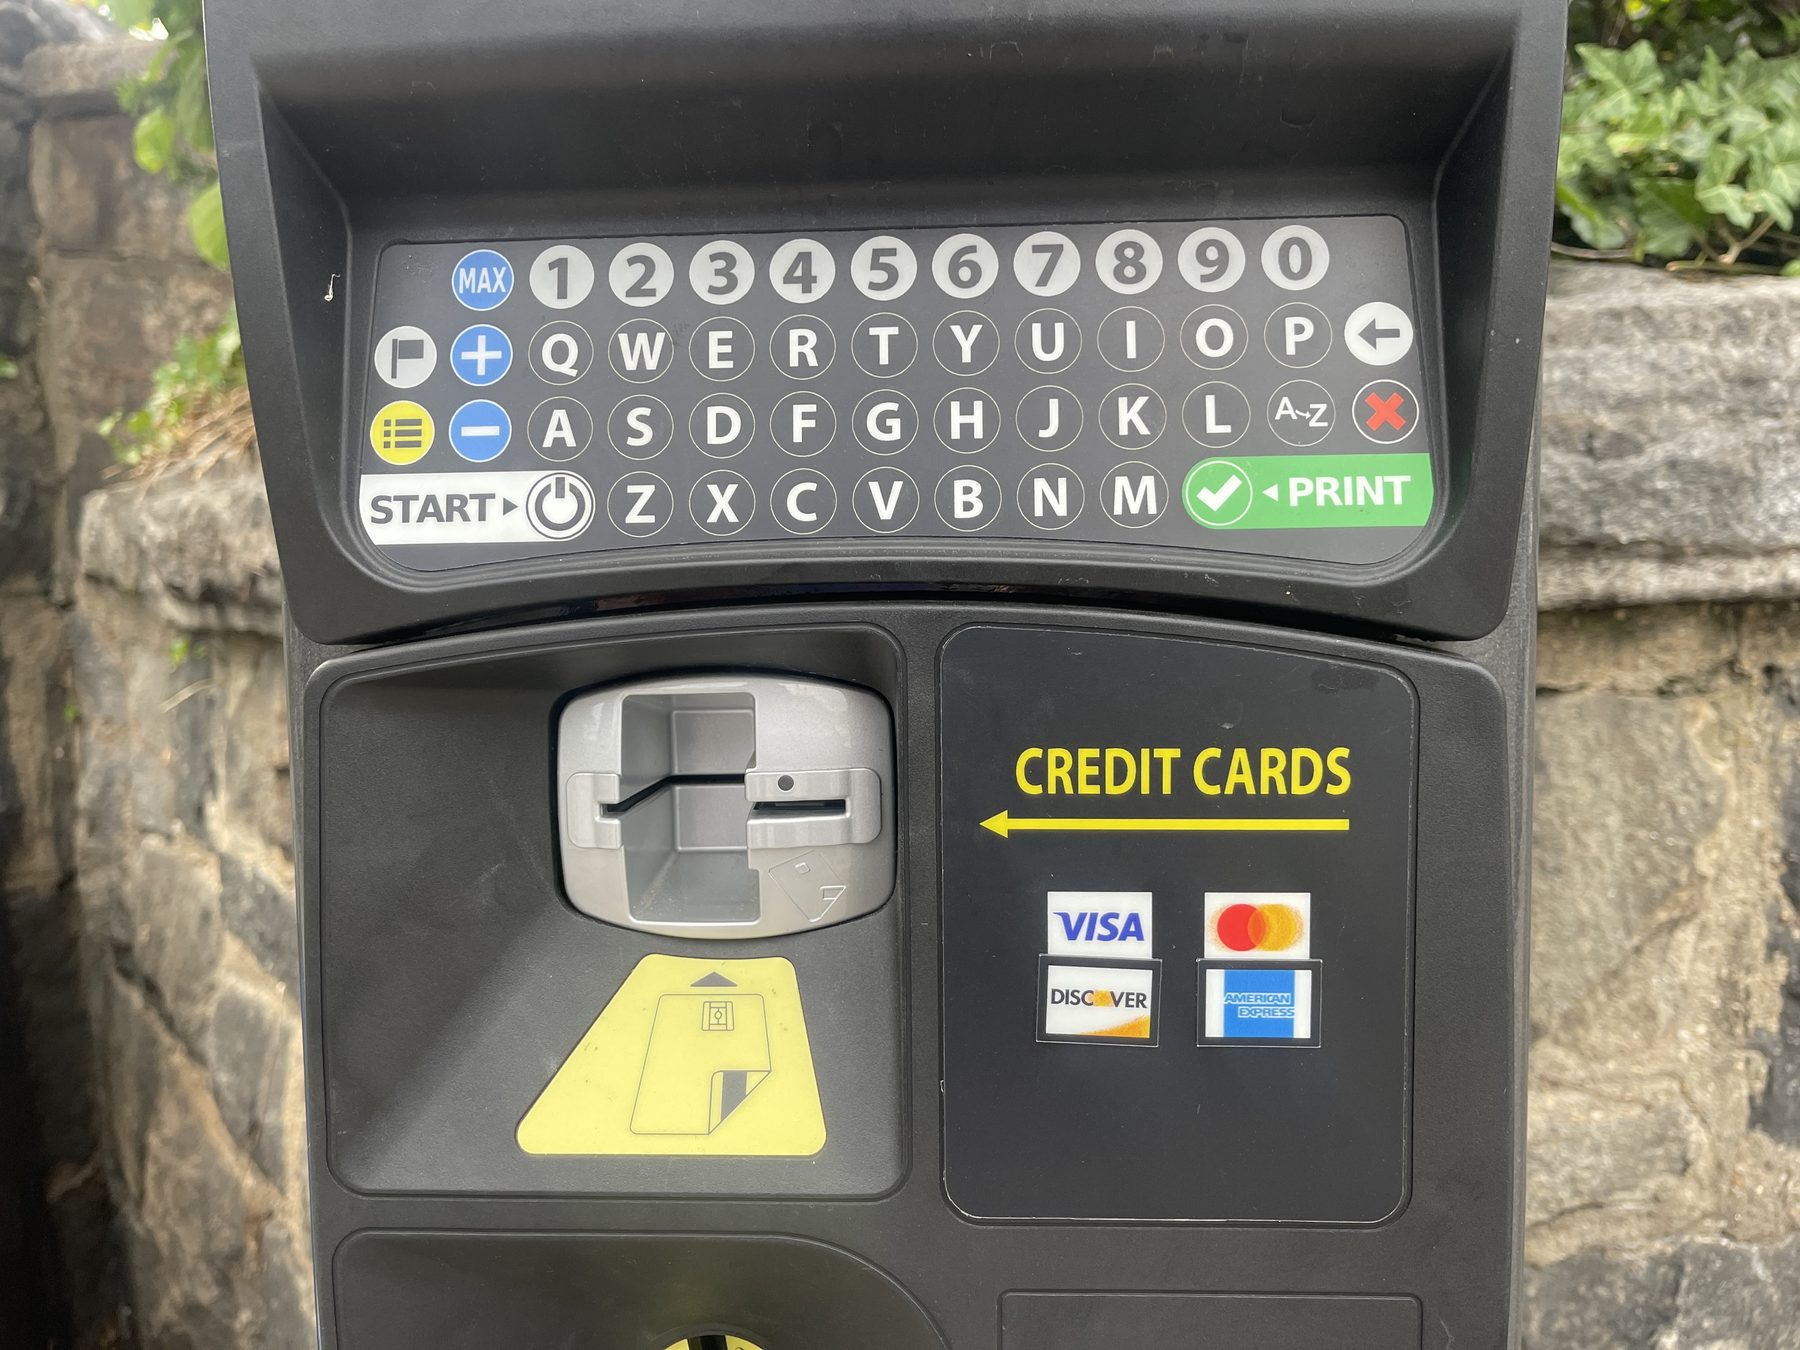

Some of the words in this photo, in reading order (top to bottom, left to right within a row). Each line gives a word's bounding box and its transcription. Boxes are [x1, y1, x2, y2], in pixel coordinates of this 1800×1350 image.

[459, 267, 506, 293] MAX
[548, 257, 569, 299] 1
[625, 255, 657, 298] 2
[708, 252, 738, 295] 3
[783, 251, 817, 294] 4
[868, 247, 899, 291] 5
[948, 245, 982, 289] 6
[1031, 244, 1063, 287] 7
[1113, 241, 1146, 285] 8
[1195, 239, 1229, 283] 9
[1278, 237, 1312, 279] 0
[541, 333, 578, 377] Q
[618, 333, 665, 371] W
[708, 331, 734, 368] E
[789, 329, 818, 368] R
[869, 326, 899, 365] T
[950, 324, 982, 363] Y
[1032, 322, 1064, 361] U
[1126, 320, 1136, 359] I
[1195, 318, 1234, 358] O
[1285, 317, 1314, 355] P
[542, 410, 576, 448] A
[626, 407, 653, 446] S
[707, 406, 741, 445] D
[792, 404, 816, 443] F
[866, 402, 902, 442] G
[950, 400, 983, 439] H
[1039, 398, 1059, 437] J
[1118, 396, 1150, 436] K
[1205, 394, 1231, 433] L
[625, 485, 656, 523] Z
[707, 484, 739, 523] X
[786, 482, 817, 522] C
[868, 480, 903, 522] V
[953, 479, 983, 518] B
[1034, 477, 1067, 517] N
[1113, 475, 1156, 515] M
[1289, 475, 1411, 506] PRINT
[370, 494, 495, 525] START
[1015, 747, 1180, 795] CREDIT
[1193, 747, 1351, 795] CARDS
[1053, 912, 1145, 941] VISA
[1224, 993, 1290, 1004] AMERICAN
[1238, 1007, 1295, 1017] EXPRESS
